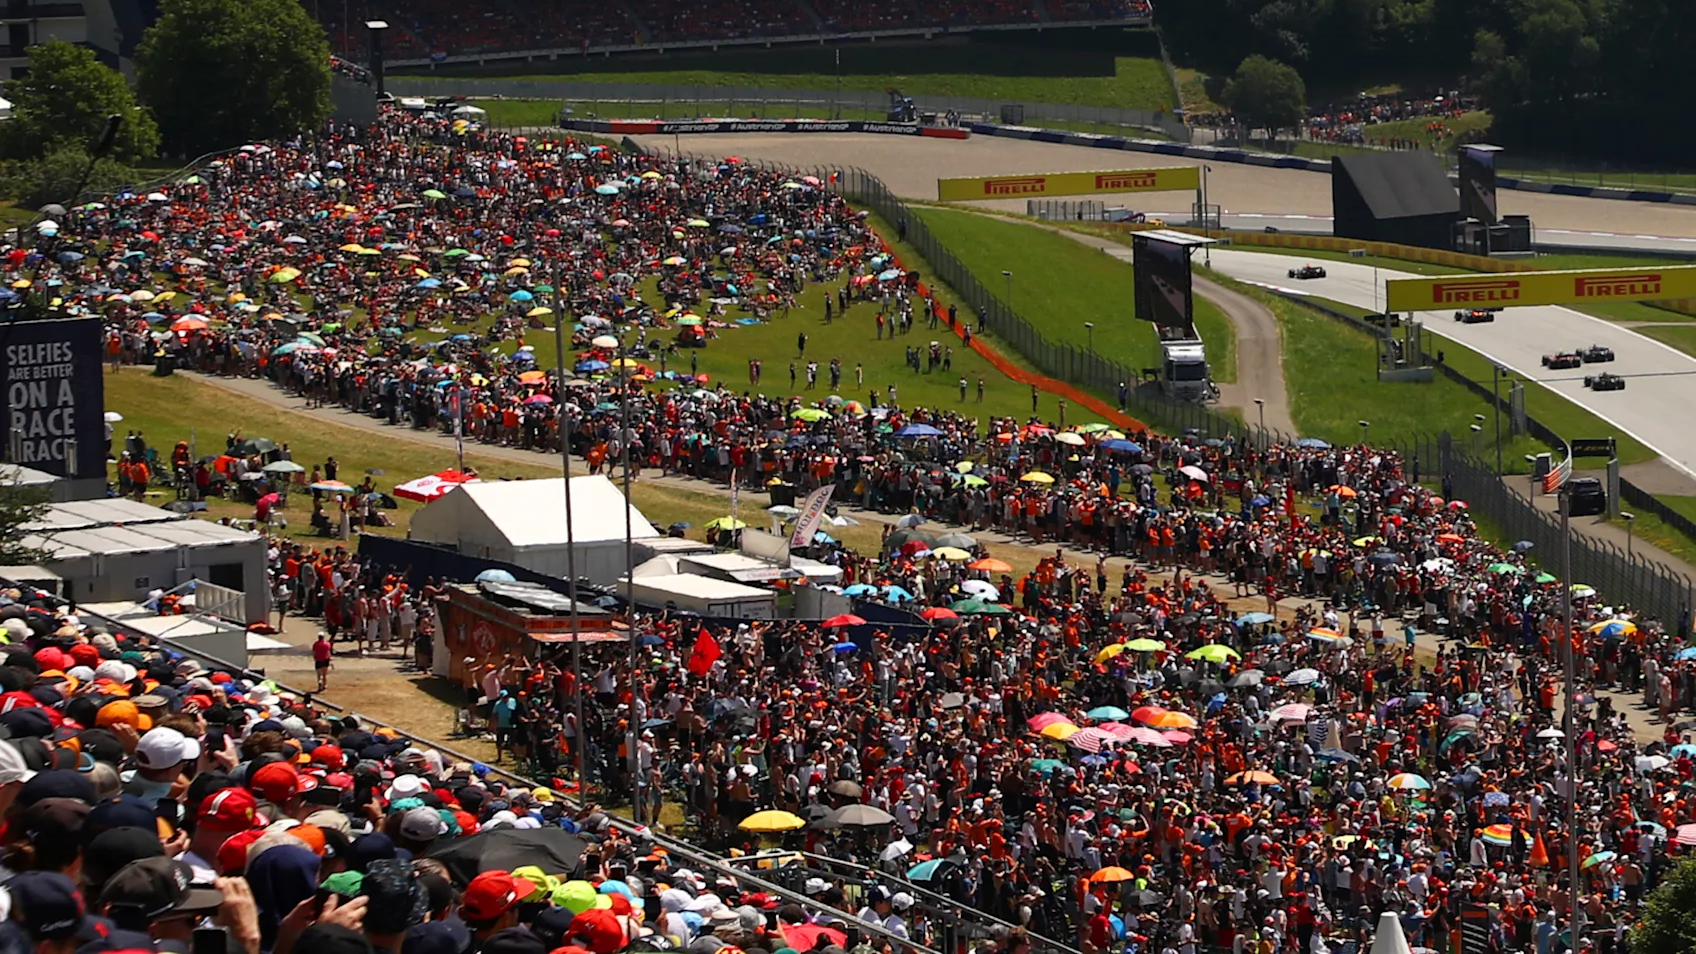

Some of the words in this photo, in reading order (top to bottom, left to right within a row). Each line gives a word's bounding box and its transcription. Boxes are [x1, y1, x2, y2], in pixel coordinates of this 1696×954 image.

[984, 178, 1046, 195] PIRELLI
[1096, 172, 1156, 189] PIRELLI
[1432, 280, 1520, 303] PIRELLI
[1574, 274, 1662, 297] PIRELLI
[6, 341, 73, 366] SELFIES
[7, 366, 30, 381] ARE
[33, 363, 74, 379] BETTER
[8, 381, 48, 410] ON
[57, 379, 74, 407] A
[10, 407, 75, 439] RACE
[14, 438, 71, 463] RAC
